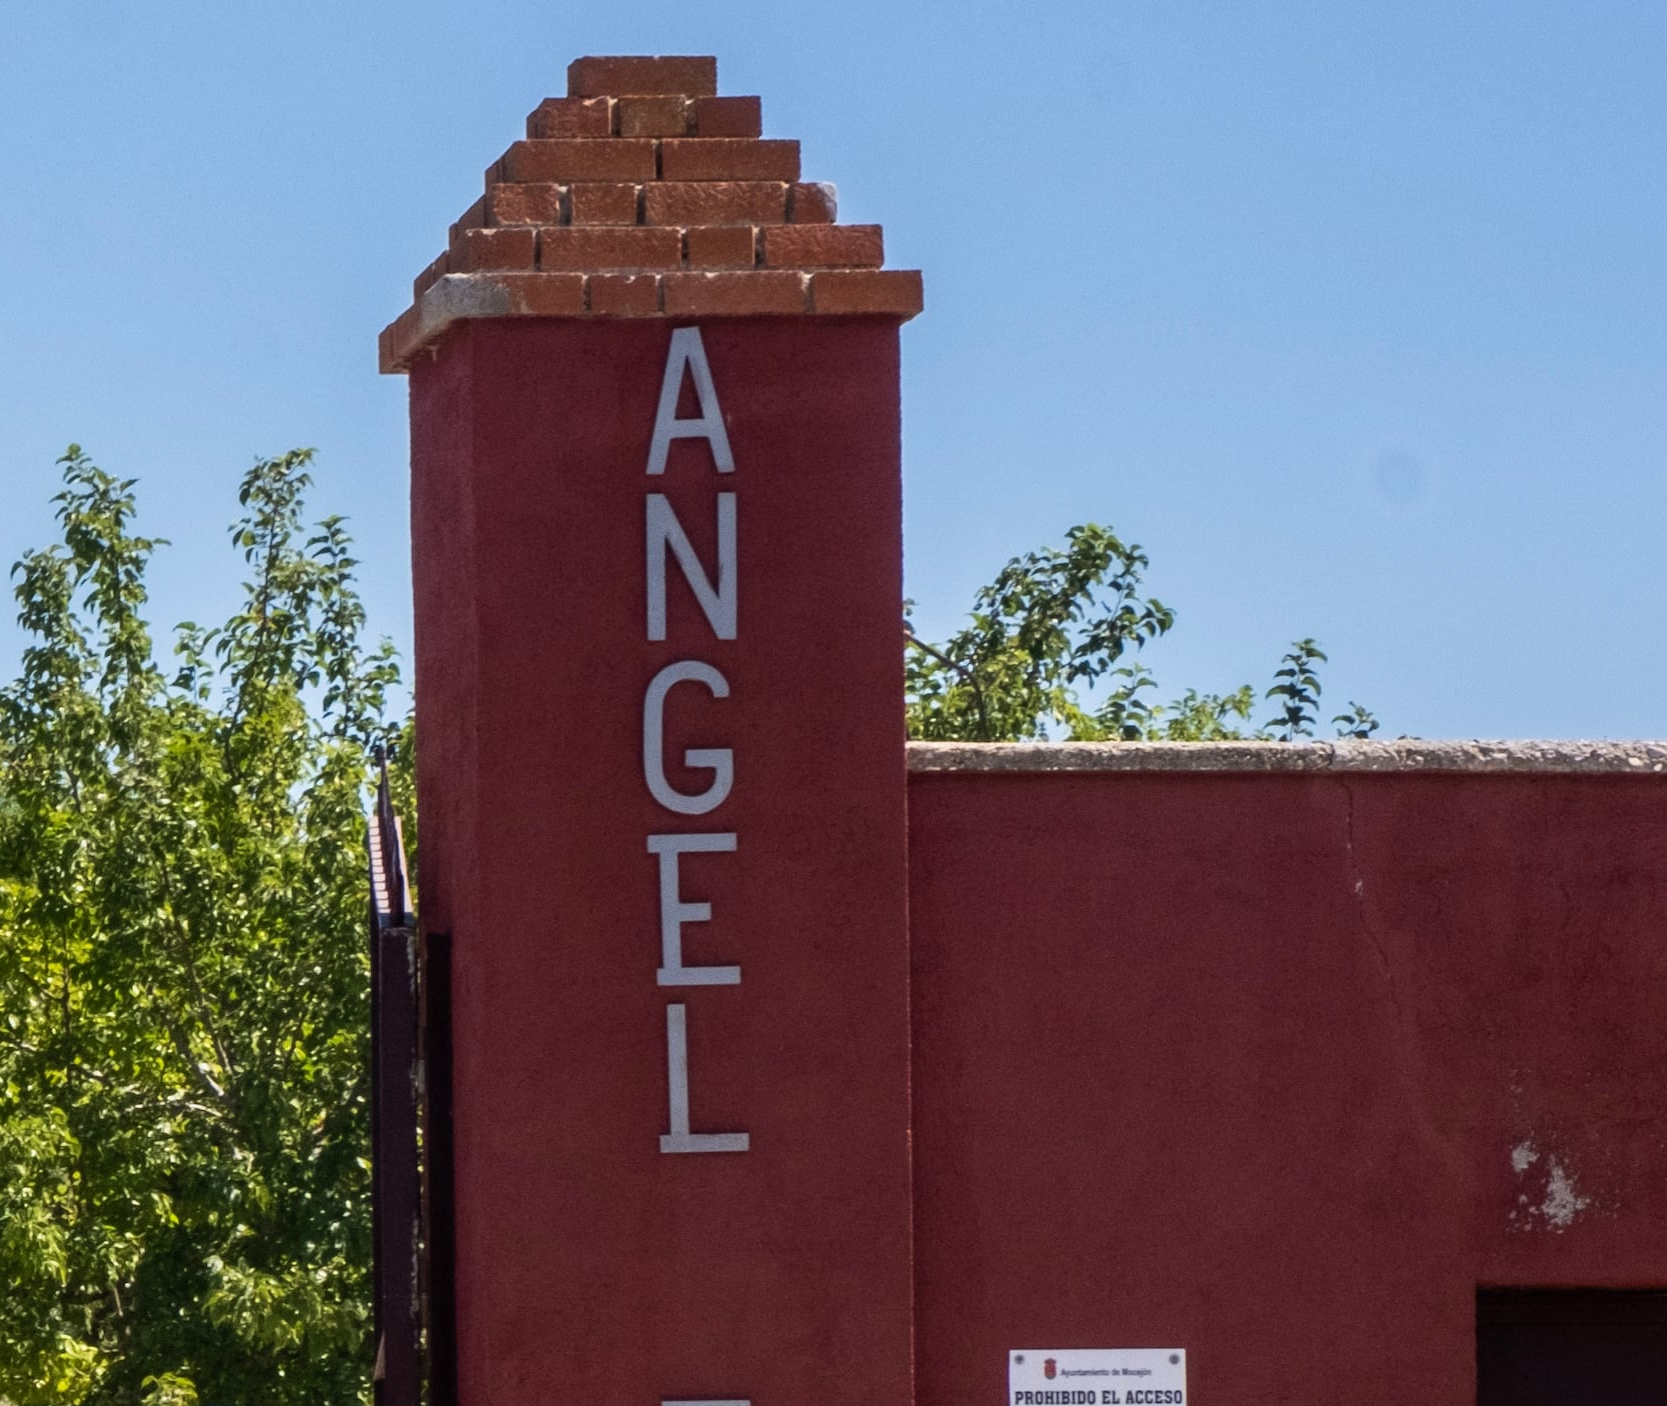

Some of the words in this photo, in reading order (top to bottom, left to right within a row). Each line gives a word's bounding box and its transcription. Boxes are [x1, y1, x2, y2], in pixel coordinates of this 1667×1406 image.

[643, 326, 750, 1153] ANGEL
[1060, 1368, 1109, 1378] Ayuntamiento
[1015, 1391, 1096, 1405] PROHIBIDO
[1102, 1391, 1120, 1405] EL
[1125, 1390, 1183, 1405] ACCESO
